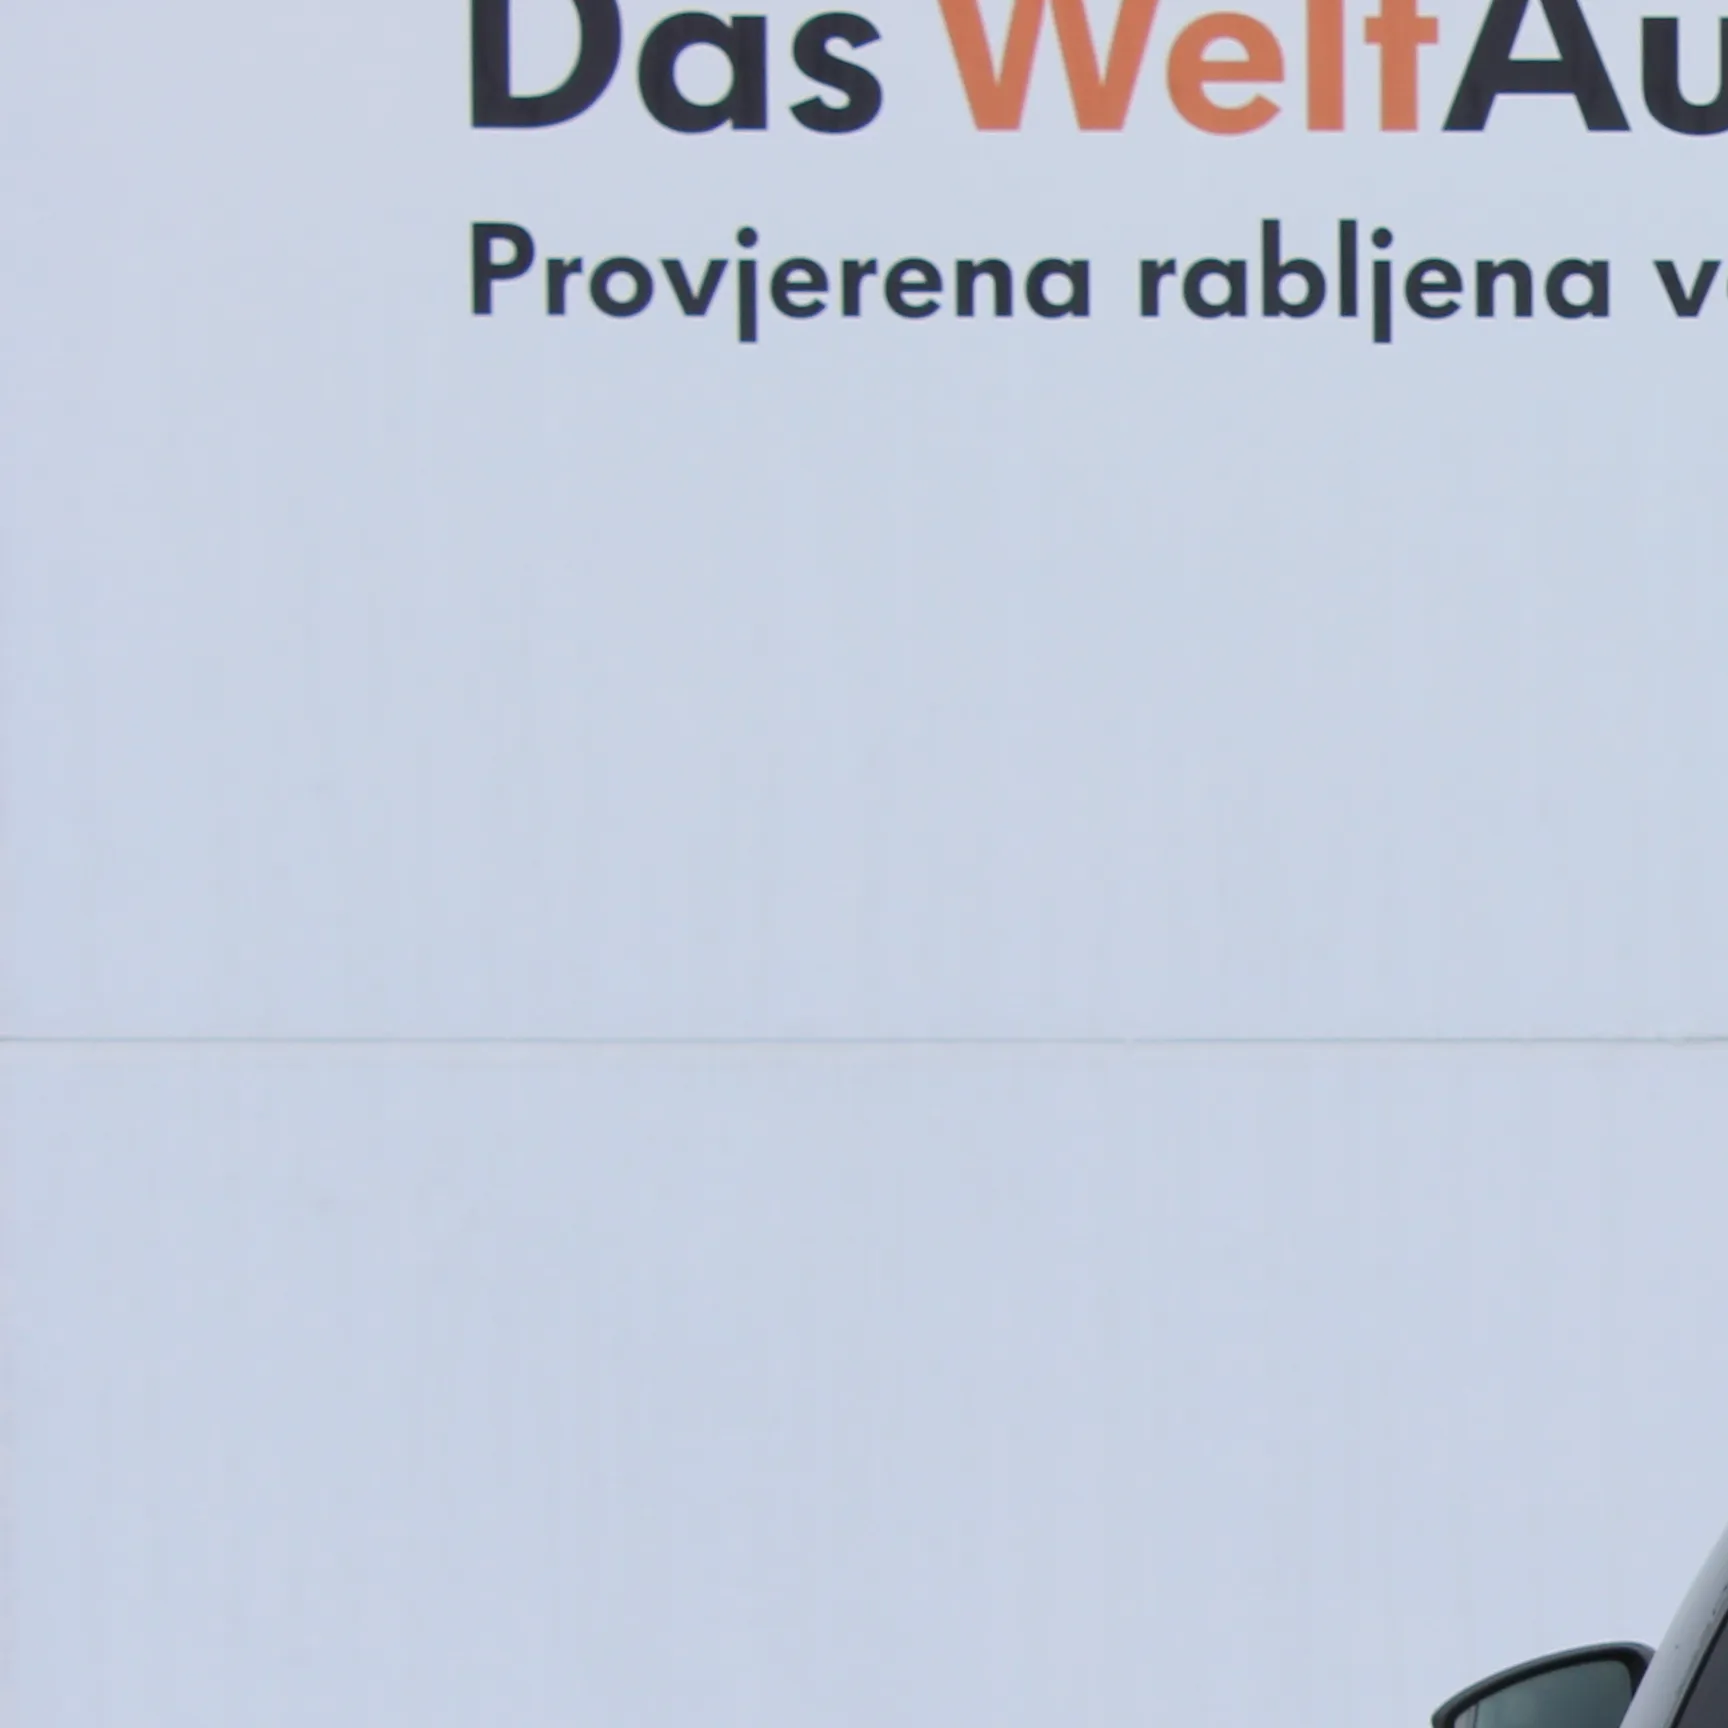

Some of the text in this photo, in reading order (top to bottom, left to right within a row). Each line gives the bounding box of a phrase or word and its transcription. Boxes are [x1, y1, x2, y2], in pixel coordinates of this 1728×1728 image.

[471, 0, 881, 132] Das
[471, 222, 1089, 342] Provjerena
[1141, 219, 1609, 343] rabljena
